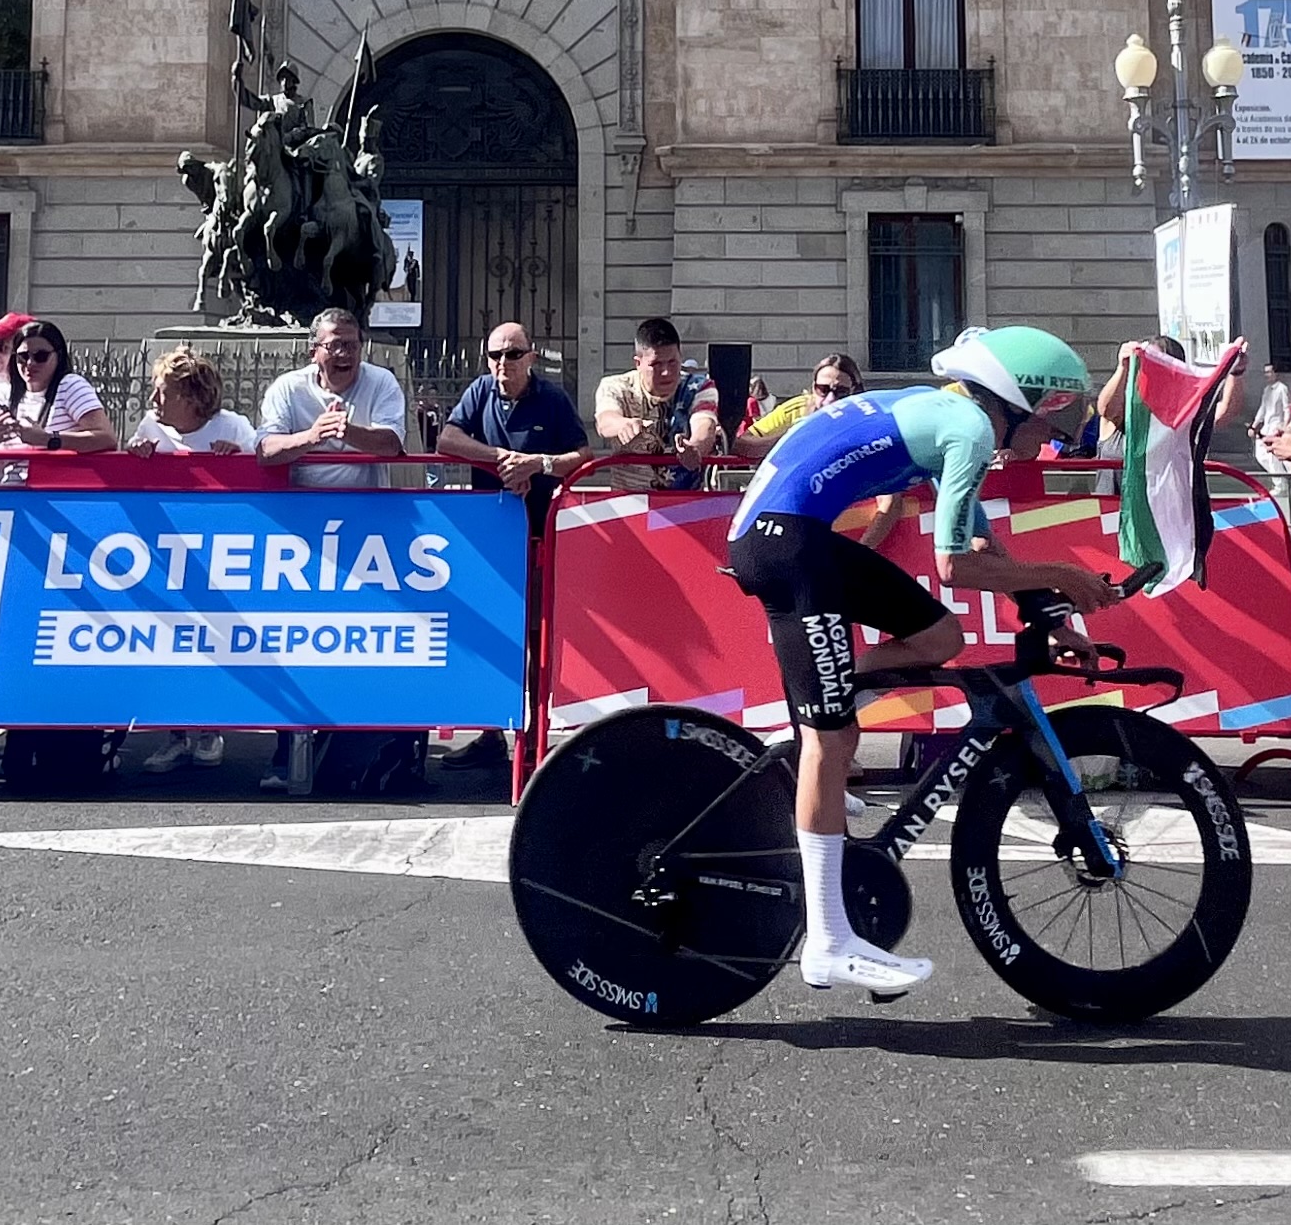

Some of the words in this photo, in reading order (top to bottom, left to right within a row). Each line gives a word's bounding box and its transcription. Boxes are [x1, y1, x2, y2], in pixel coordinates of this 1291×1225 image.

[1242, 52, 1274, 65] cademia
[1251, 66, 1275, 79] 1850
[1016, 373, 1045, 386] VAN
[821, 435, 894, 480] DECATHLON
[43, 519, 451, 591] LOTERÍAS
[68, 624, 157, 653] CON
[173, 624, 215, 654] EL
[229, 624, 416, 654] DEPORTE
[823, 612, 845, 667] AG2R
[839, 670, 854, 697] LA
[802, 615, 843, 715] MONDIALE
[923, 736, 998, 812] RYSEL
[596, 979, 644, 1010] SWISS
